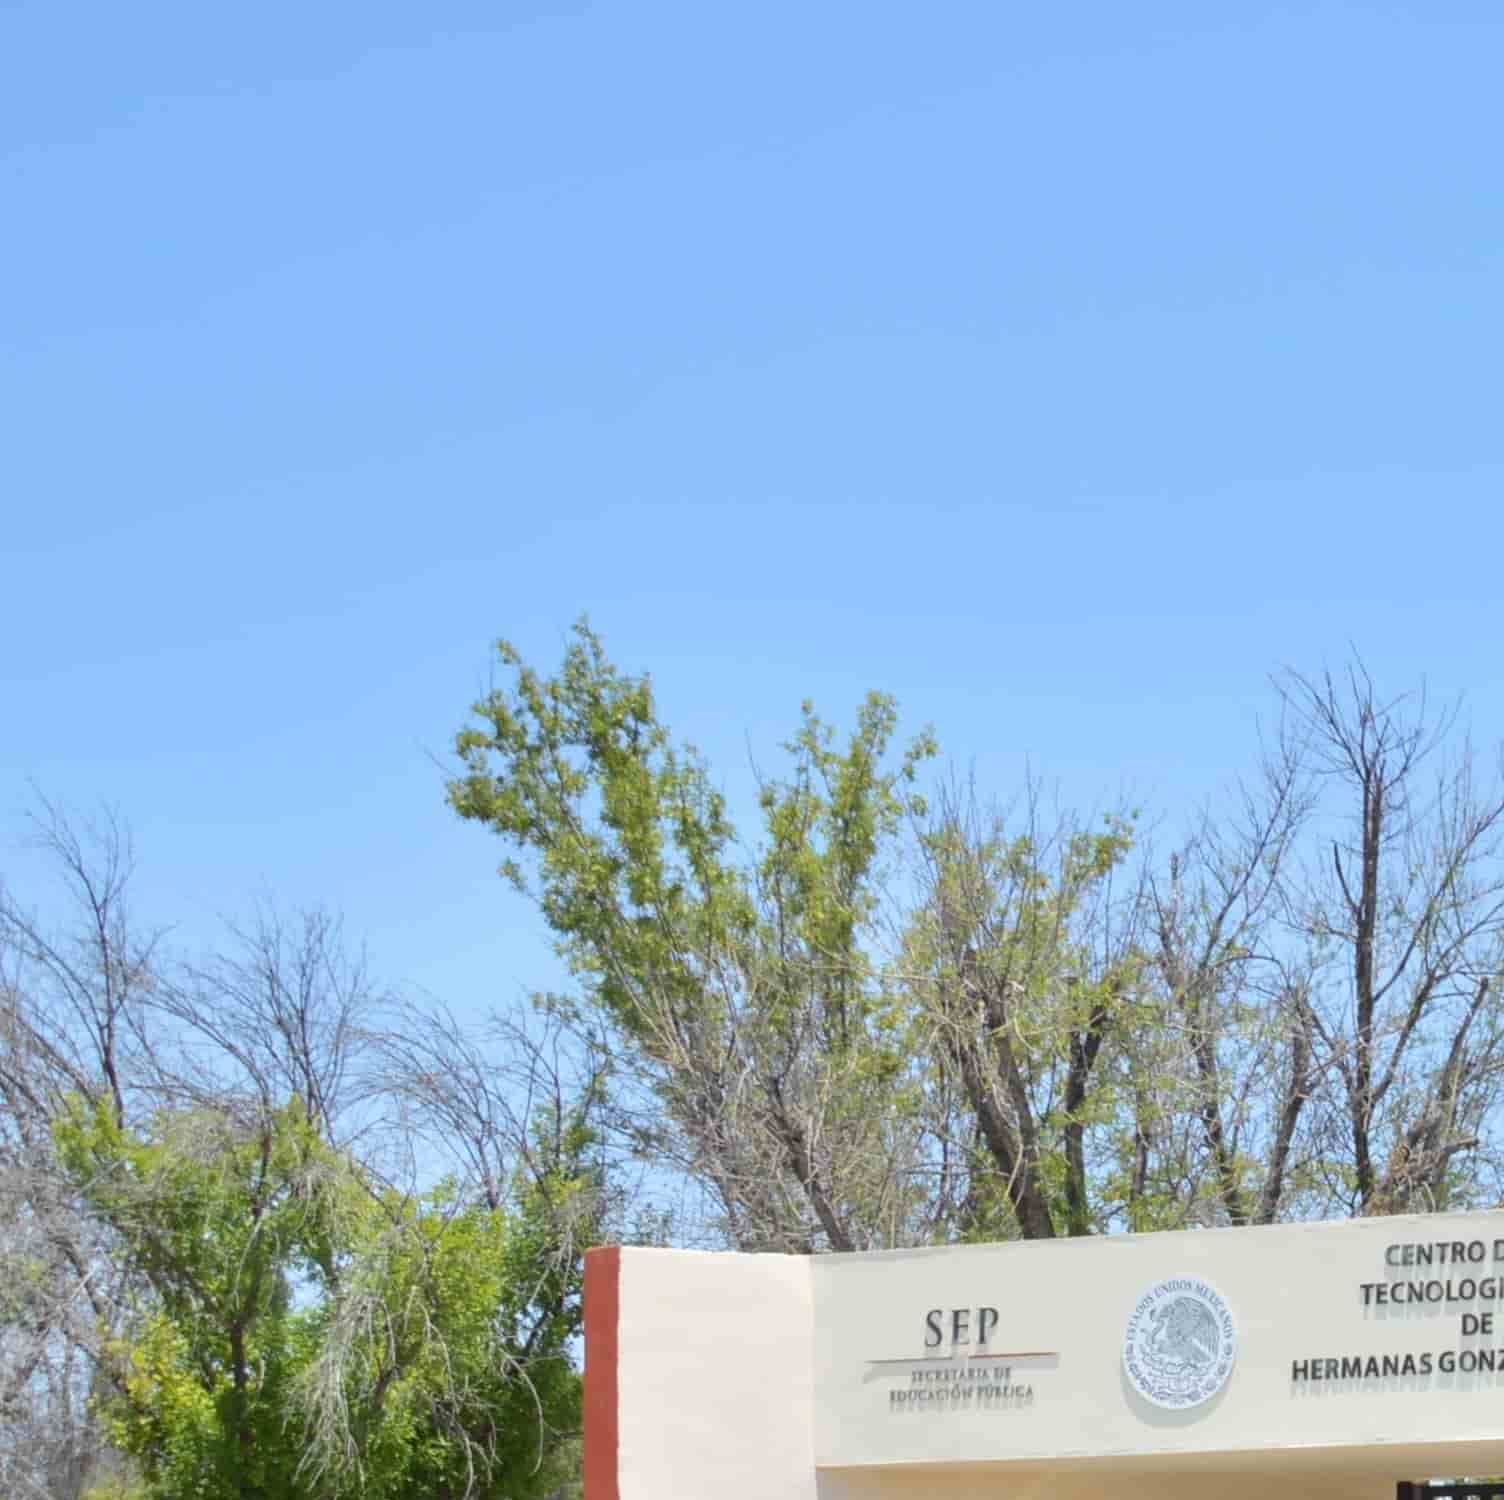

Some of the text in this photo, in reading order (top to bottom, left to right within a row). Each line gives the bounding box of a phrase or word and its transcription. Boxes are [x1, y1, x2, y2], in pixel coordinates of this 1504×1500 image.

[1385, 1240, 1486, 1266] CENTRO
[924, 1306, 1000, 1348] SEP
[1462, 1312, 1494, 1336] DE
[1291, 1352, 1433, 1382] HERMANAS
